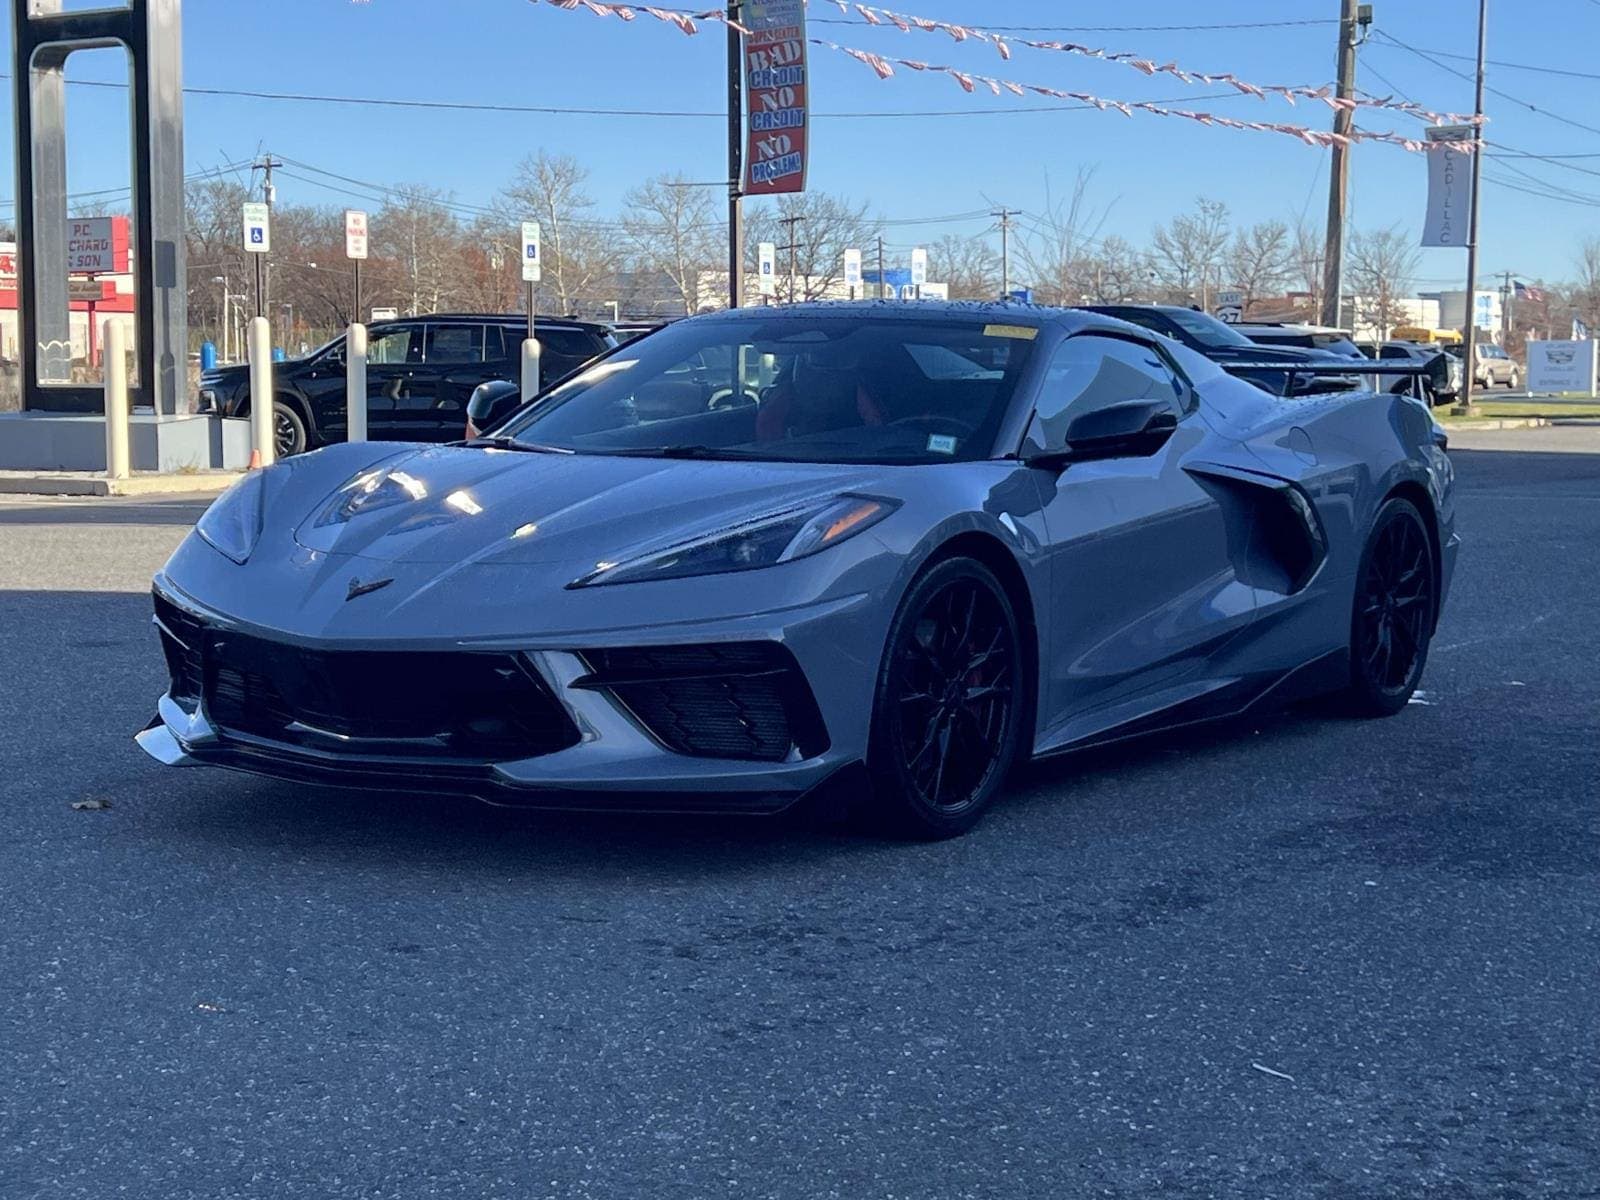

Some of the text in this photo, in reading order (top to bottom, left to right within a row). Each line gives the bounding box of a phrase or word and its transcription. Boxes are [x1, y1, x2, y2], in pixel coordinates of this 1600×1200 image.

[750, 40, 802, 71] BAD
[751, 66, 803, 87] CREDIT
[760, 86, 795, 112] NO
[752, 109, 804, 129] CREDIT
[756, 134, 791, 160] NO
[752, 153, 801, 182] PROBLEM!
[1440, 150, 1454, 243] CADILLAC
[68, 239, 109, 252] CHARD
[76, 254, 102, 267] SON
[1219, 312, 1239, 323] 27
